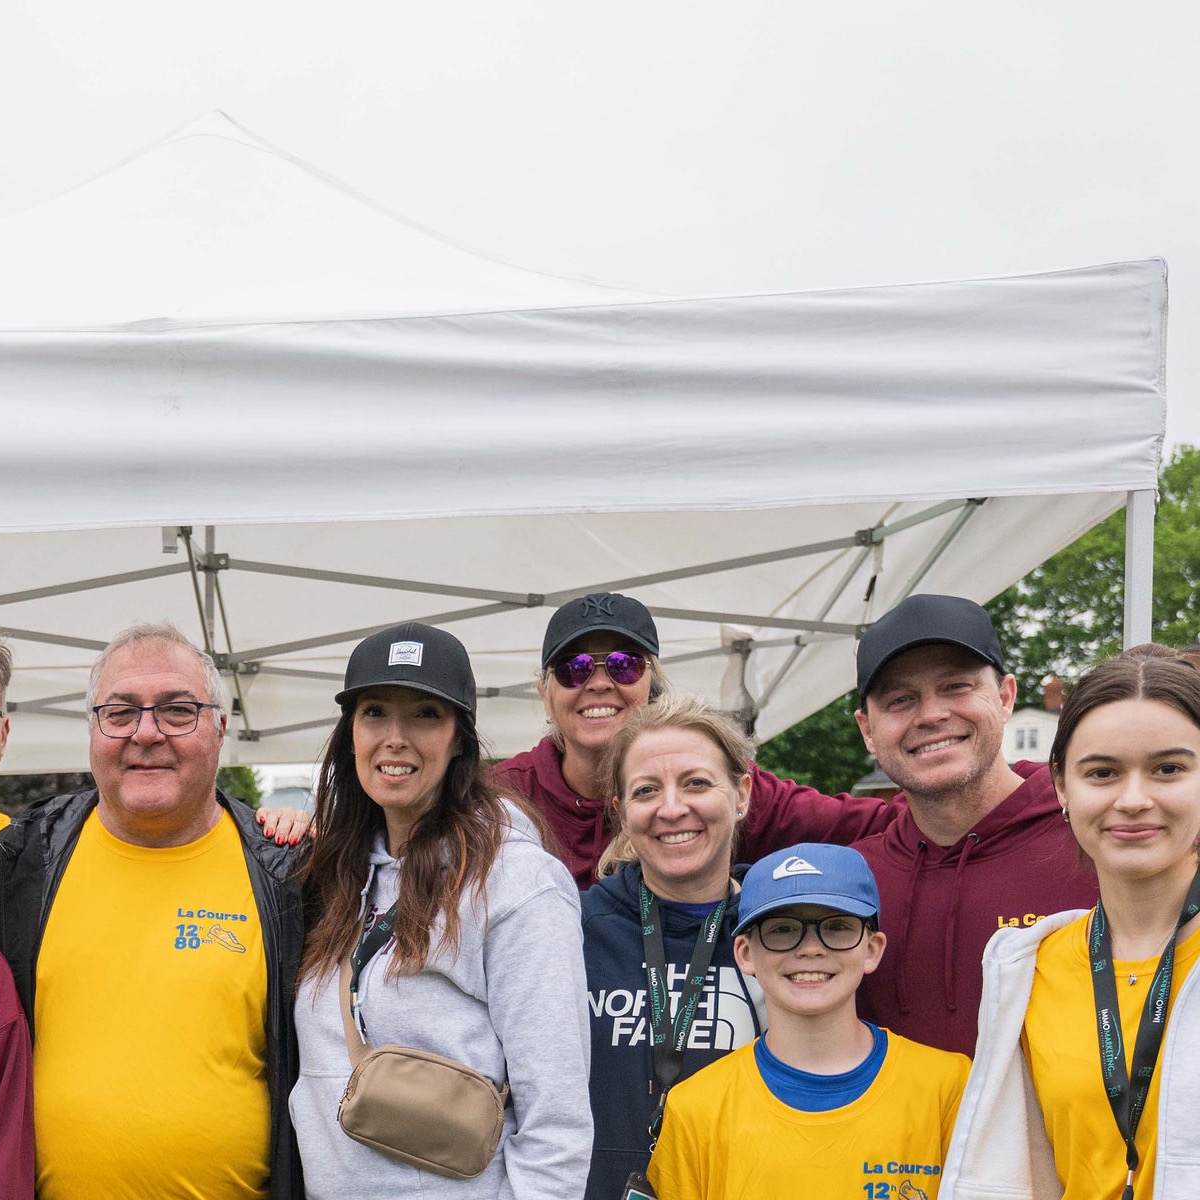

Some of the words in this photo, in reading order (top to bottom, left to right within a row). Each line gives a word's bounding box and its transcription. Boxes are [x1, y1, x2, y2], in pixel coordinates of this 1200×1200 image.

[177, 908, 194, 918] La
[196, 909, 247, 921] Course
[998, 916, 1019, 928] La
[611, 1016, 713, 1050] FAE
[863, 1162, 883, 1174] La
[886, 1161, 940, 1175] Course
